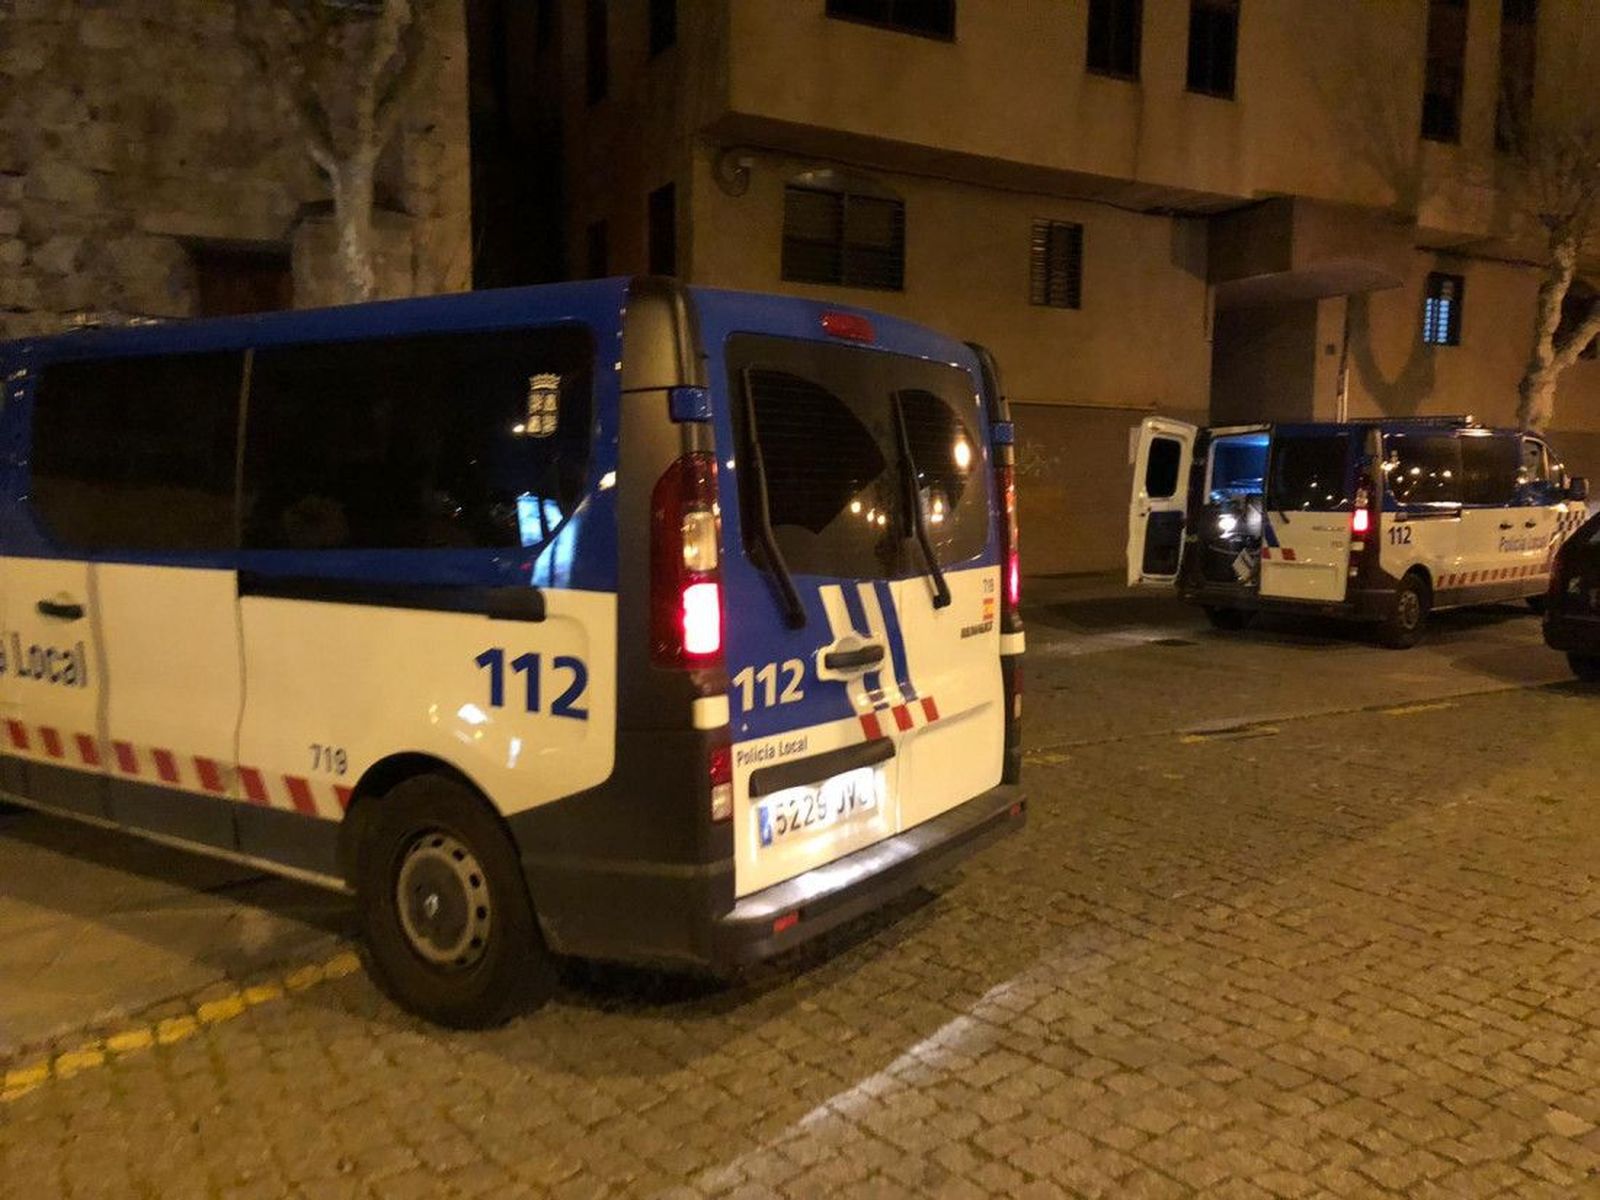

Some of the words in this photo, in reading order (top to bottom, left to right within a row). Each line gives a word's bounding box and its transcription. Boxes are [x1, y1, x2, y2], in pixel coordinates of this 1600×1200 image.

[1387, 526, 1413, 545] 112
[10, 632, 88, 689] Local
[474, 647, 589, 721] 112
[732, 657, 806, 712] 112
[779, 735, 808, 758] Local
